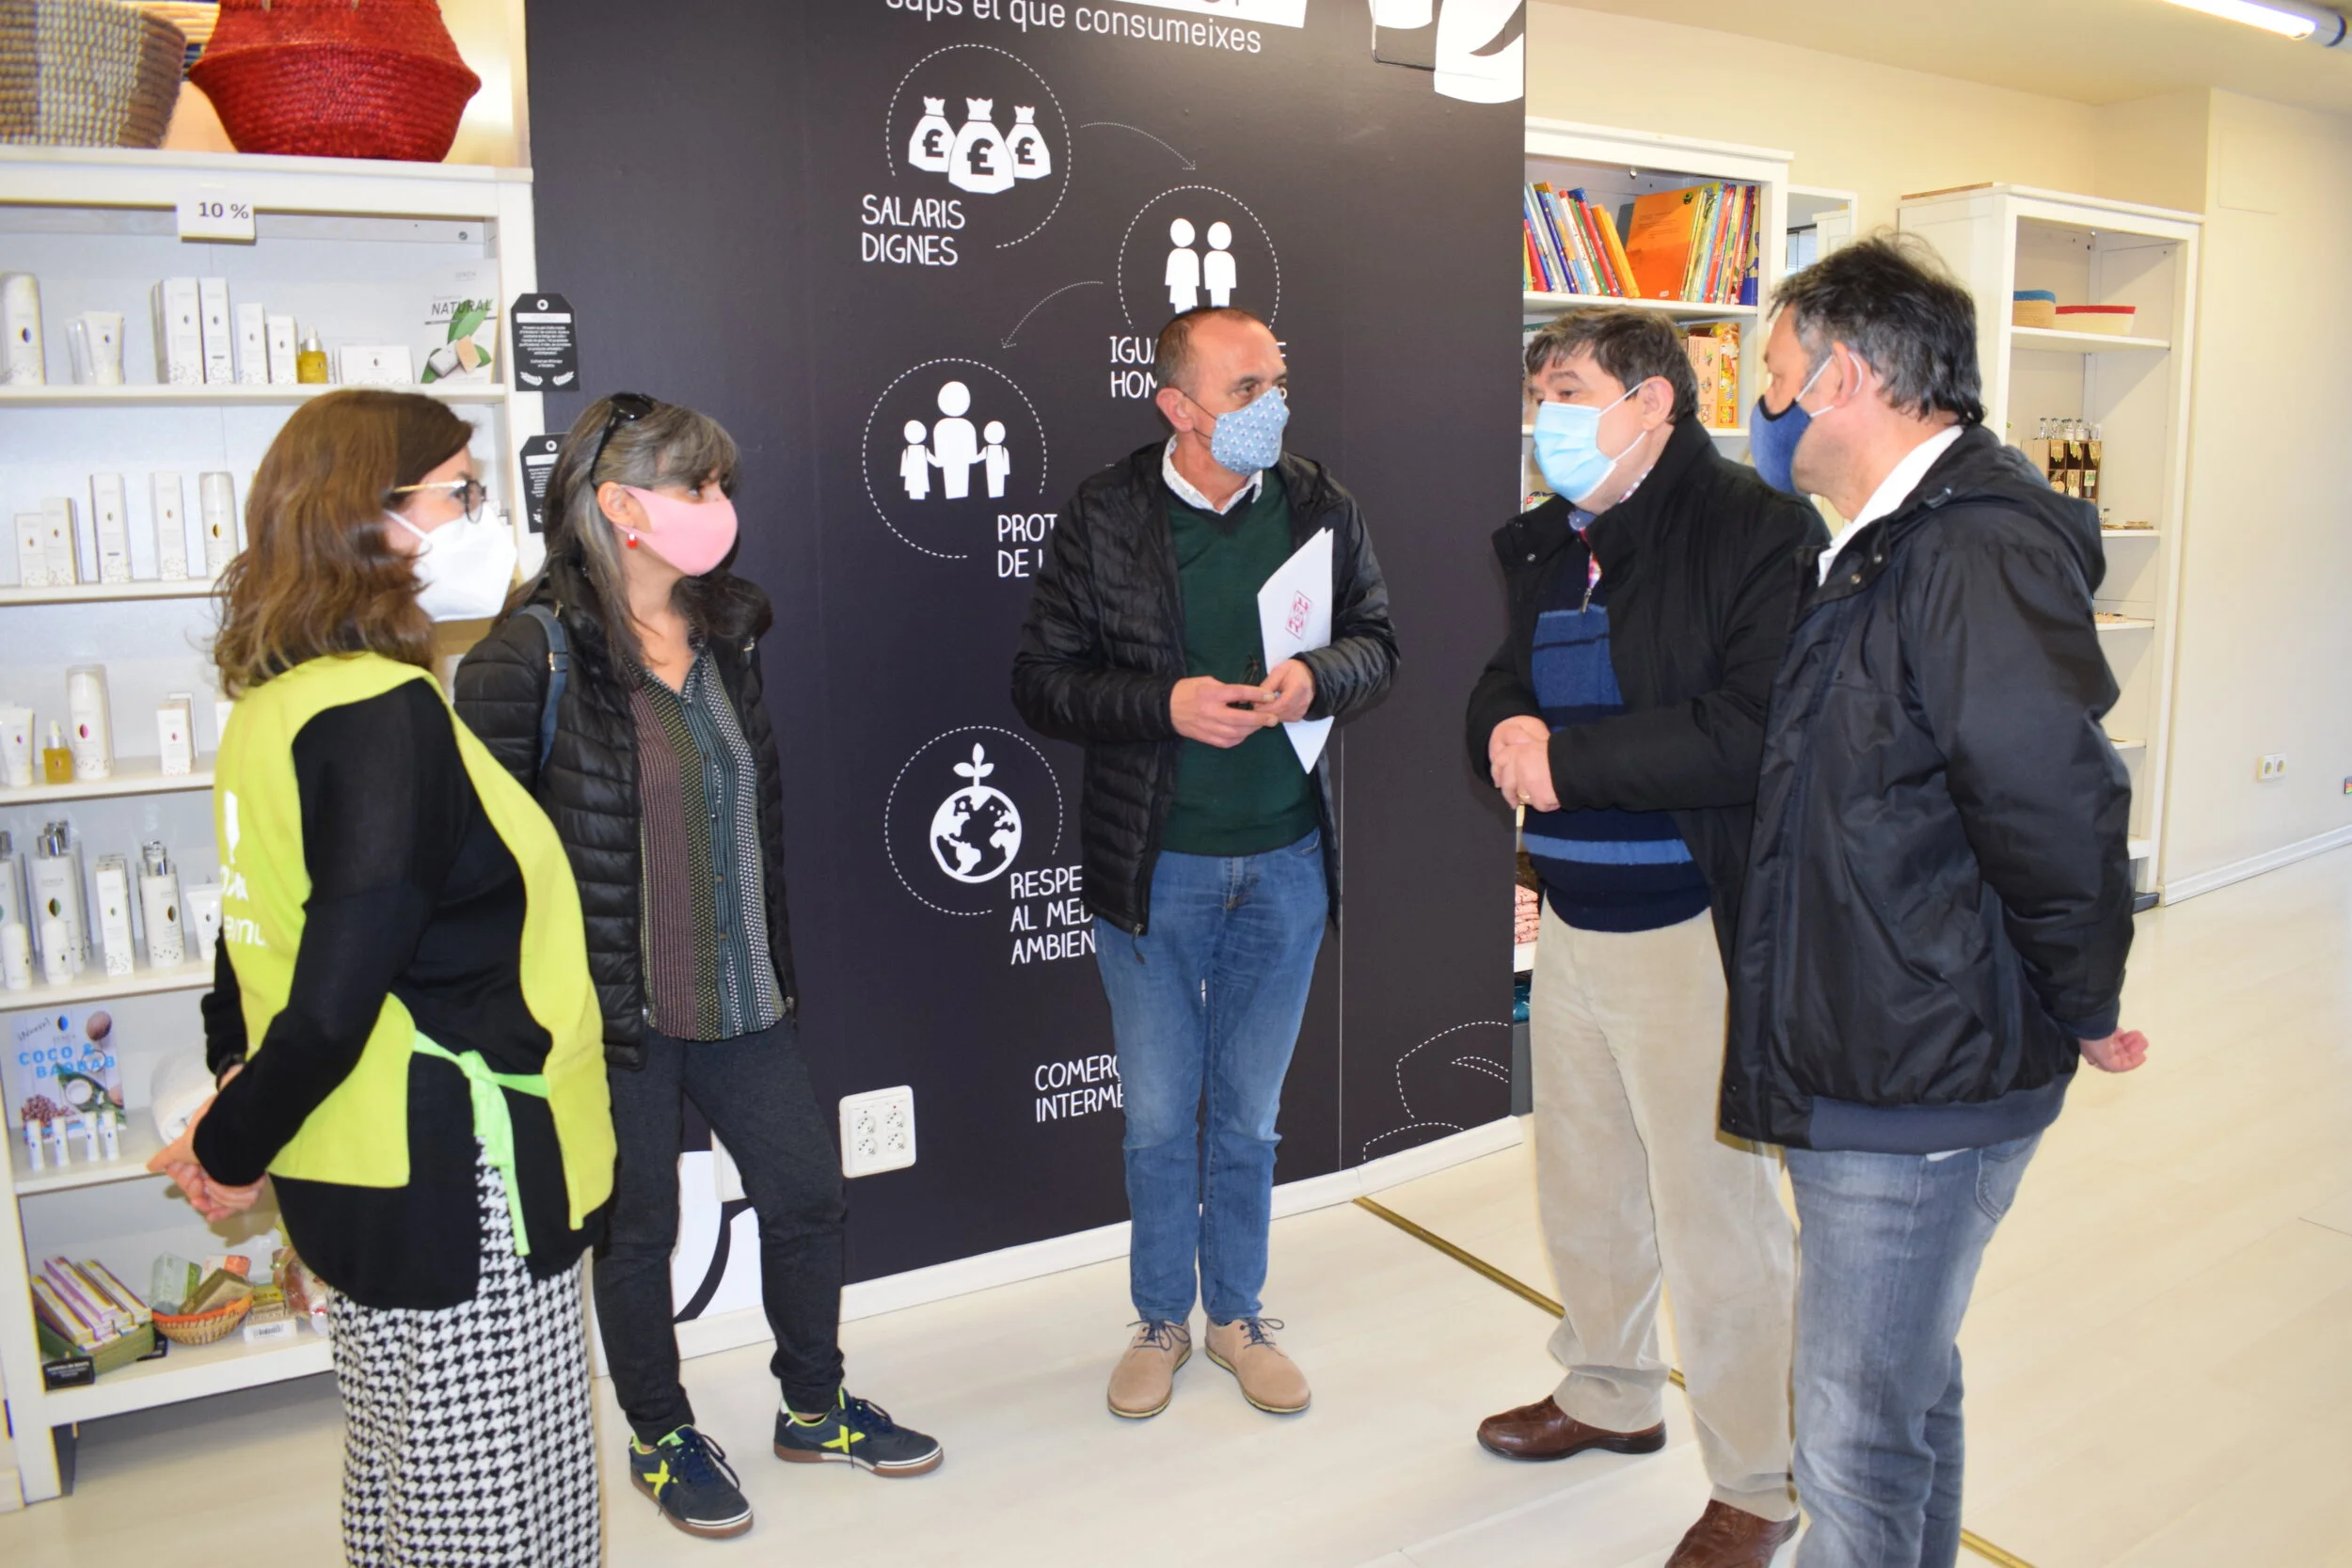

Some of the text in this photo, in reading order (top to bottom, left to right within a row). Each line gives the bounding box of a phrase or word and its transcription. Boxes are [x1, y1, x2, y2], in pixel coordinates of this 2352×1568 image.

[973, 0, 1001, 20] el
[1009, 0, 1065, 33] que
[1075, 8, 1262, 54] consumeixes
[199, 201, 249, 219] 10 %
[861, 194, 965, 230] SALARIS
[862, 231, 959, 266] DIGNES
[432, 298, 493, 316] NATURAL
[997, 514, 1058, 543] PROT
[997, 548, 1030, 578] DE
[1010, 864, 1083, 899] RESPE
[1009, 905, 1038, 932] AL
[1010, 928, 1096, 965] AMBIEN
[19, 1045, 73, 1066] COCO
[36, 1055, 116, 1079] BAOBAB
